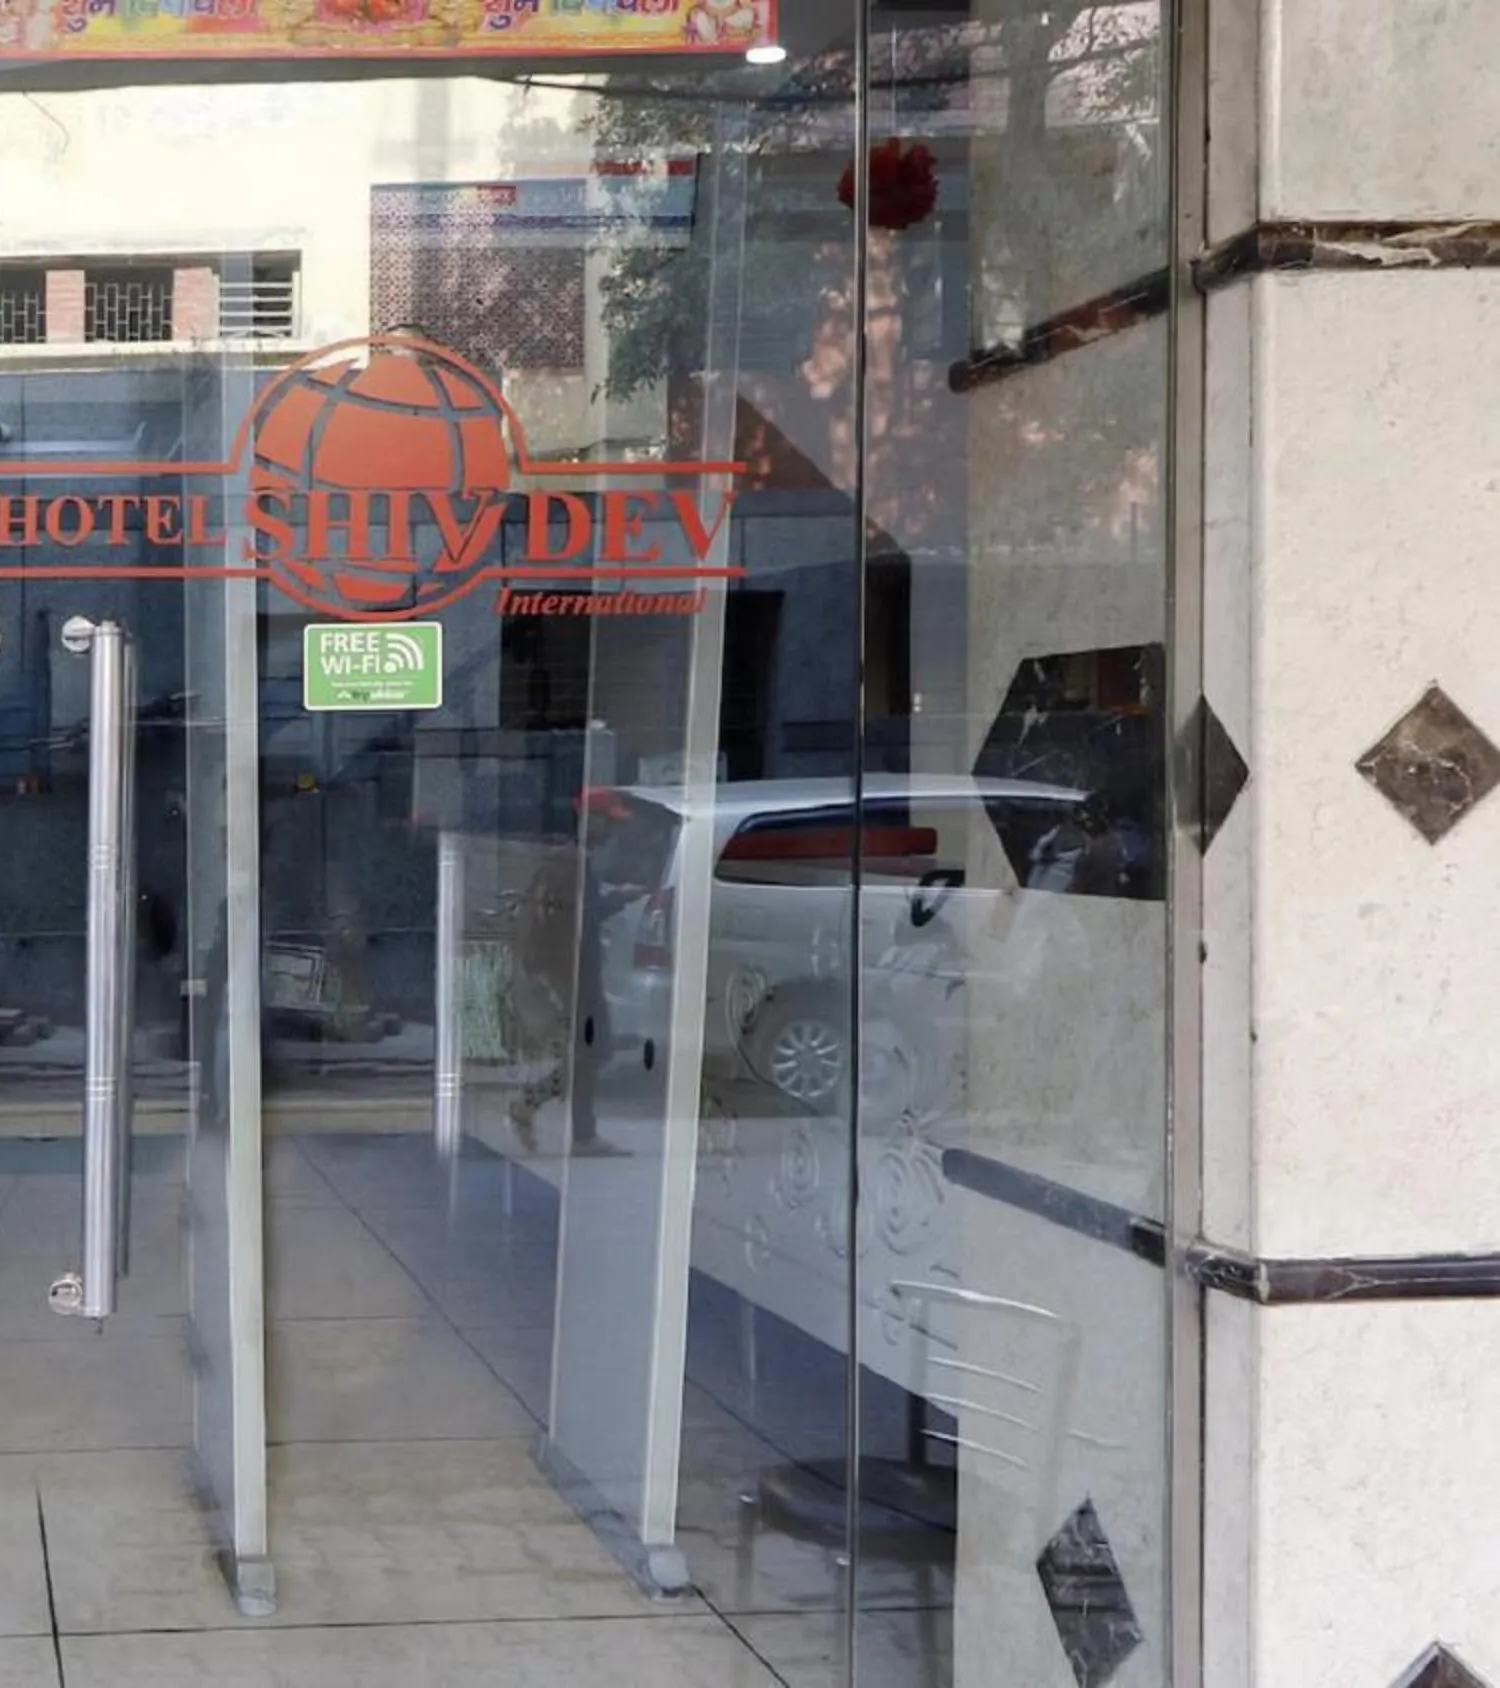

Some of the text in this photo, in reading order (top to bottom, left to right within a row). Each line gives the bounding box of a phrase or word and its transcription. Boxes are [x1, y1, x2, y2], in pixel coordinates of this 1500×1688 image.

[242, 488, 503, 565] SHIV
[521, 489, 739, 562] DEV
[494, 585, 709, 616] International
[320, 631, 381, 653] FREE
[320, 655, 381, 675] WI-FI
